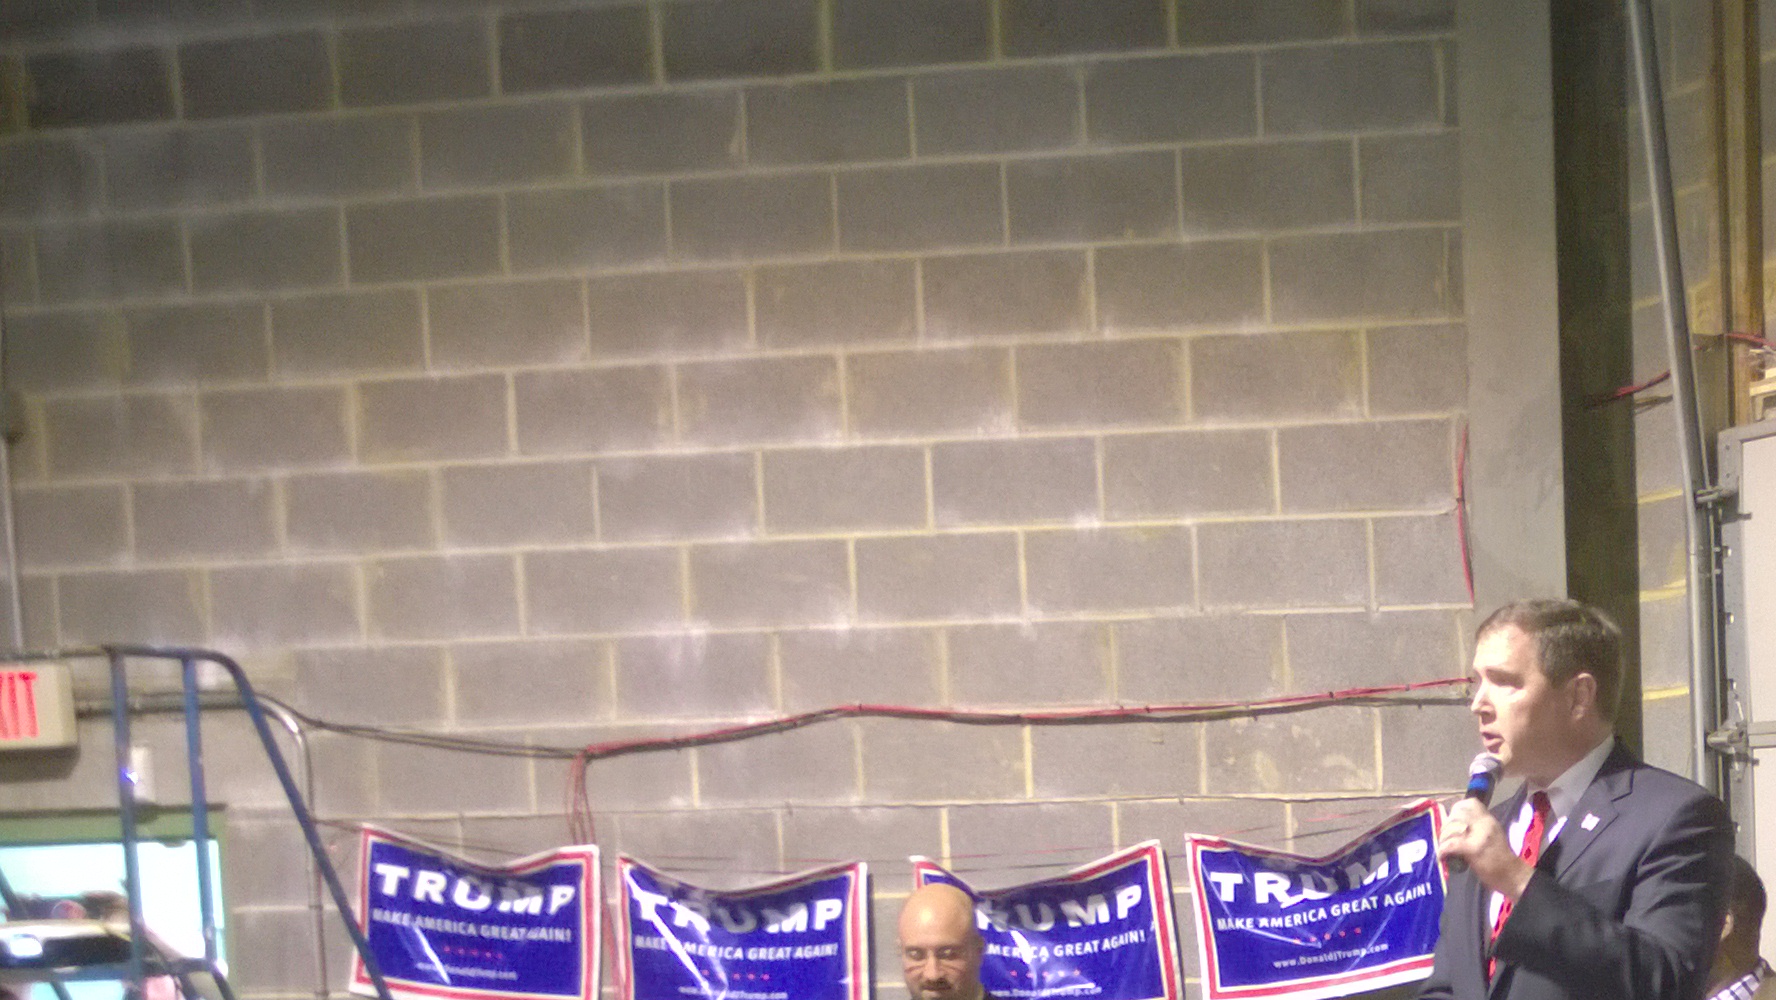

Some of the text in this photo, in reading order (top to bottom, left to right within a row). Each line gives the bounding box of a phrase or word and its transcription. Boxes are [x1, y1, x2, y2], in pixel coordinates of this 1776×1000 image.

[374, 862, 576, 915] TRUMP
[1210, 839, 1428, 908] TRUMP
[372, 907, 411, 926] MAKE
[415, 916, 478, 937] AMERICA
[974, 884, 1142, 933] RUMP
[1216, 882, 1433, 932] MAKE AMERICA GREAT AGAIN!
[747, 946, 792, 962] GREAT
[1053, 939, 1100, 958] GREAT
[1101, 929, 1147, 951] AGAIN!
